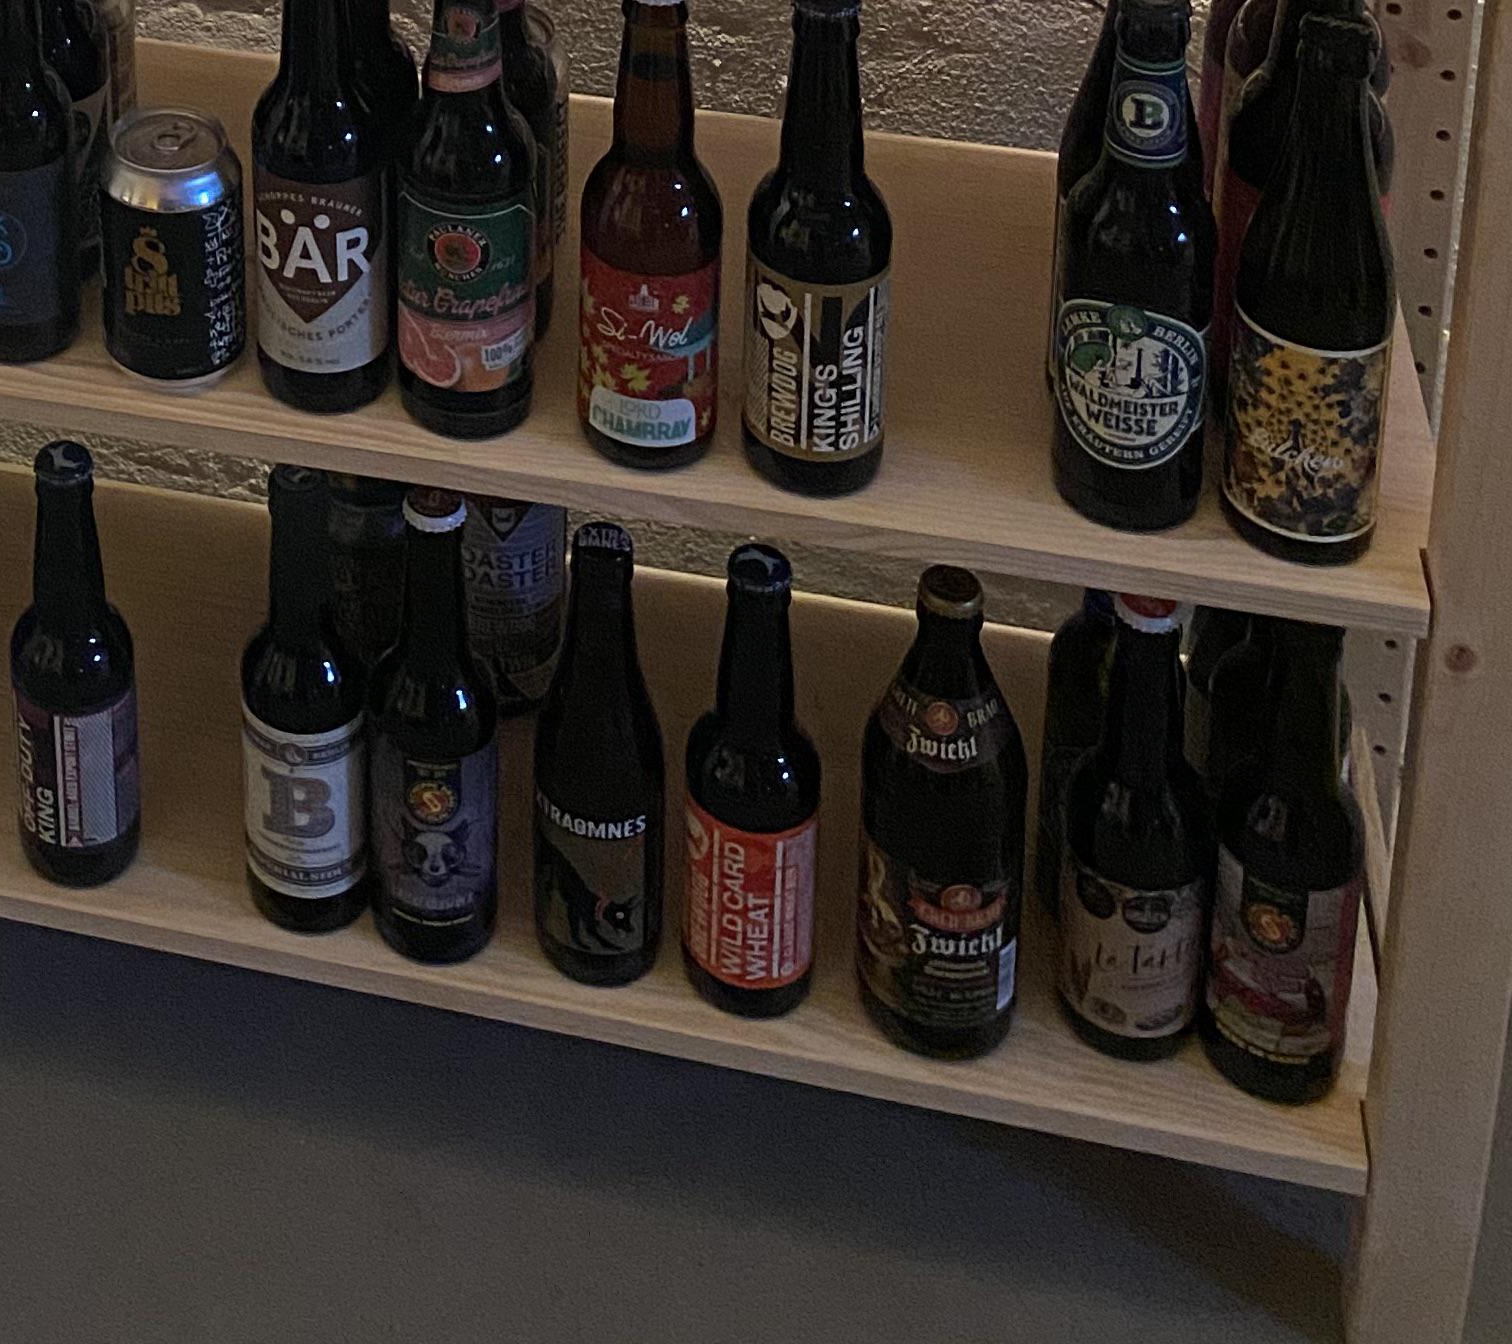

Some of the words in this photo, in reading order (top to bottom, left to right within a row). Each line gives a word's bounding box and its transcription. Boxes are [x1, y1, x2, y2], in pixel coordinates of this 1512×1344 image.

[255, 207, 372, 283] BÄR
[428, 222, 488, 248] PAULANER
[1153, 325, 1200, 366] BERLIN
[769, 346, 799, 449] BREWDOG
[811, 363, 838, 453] KING'S
[838, 325, 865, 452] SHILLING
[1069, 376, 1179, 417] WALDMEISTER
[592, 402, 693, 441] CHAMBRAY
[1086, 406, 1158, 436] WEISSE
[36, 786, 57, 845] KING
[261, 763, 335, 839] B
[723, 842, 746, 908] CARD
[720, 917, 743, 975] WILD
[745, 892, 770, 980] WHEAT
